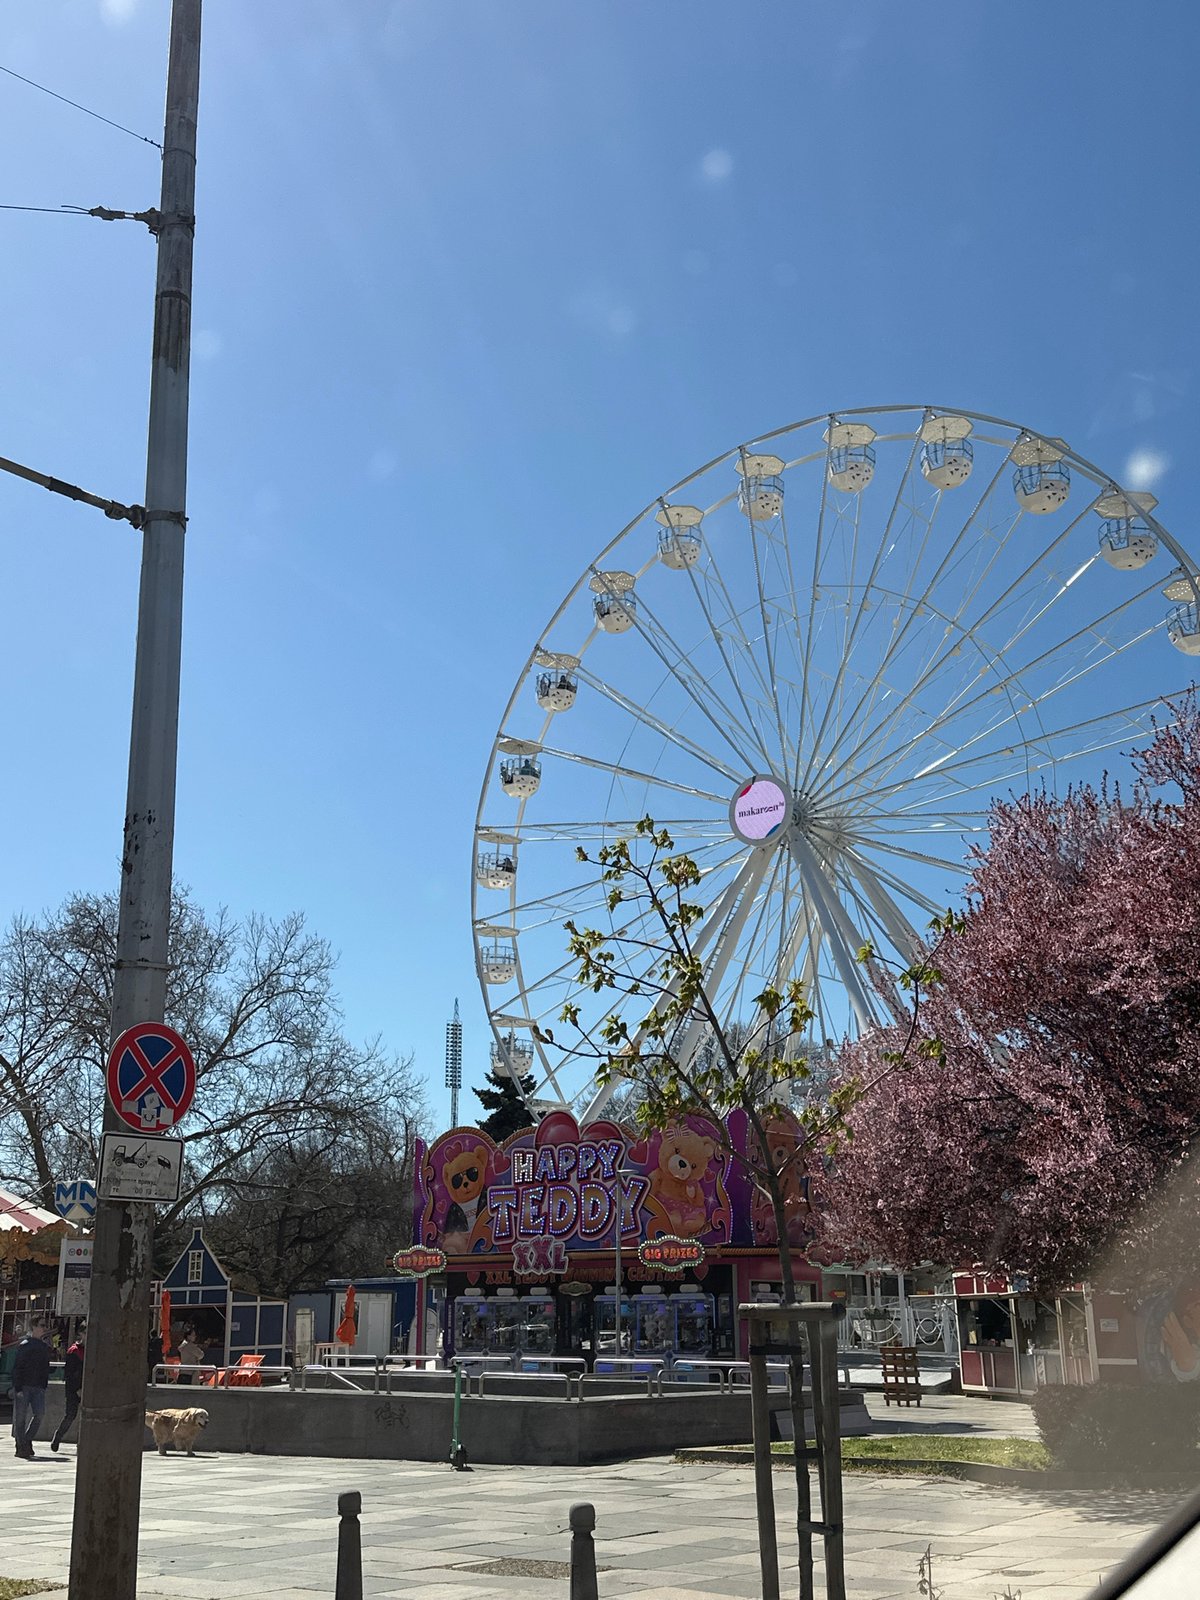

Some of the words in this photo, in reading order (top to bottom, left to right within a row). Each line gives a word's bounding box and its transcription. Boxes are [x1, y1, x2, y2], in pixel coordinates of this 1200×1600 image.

[513, 1143, 621, 1184] HAPPY
[488, 1178, 647, 1239] TEDDY
[513, 1237, 568, 1274] XXL
[644, 1248, 661, 1260] BIG
[663, 1247, 698, 1259] PRIZES
[485, 1270, 512, 1285] XXL
